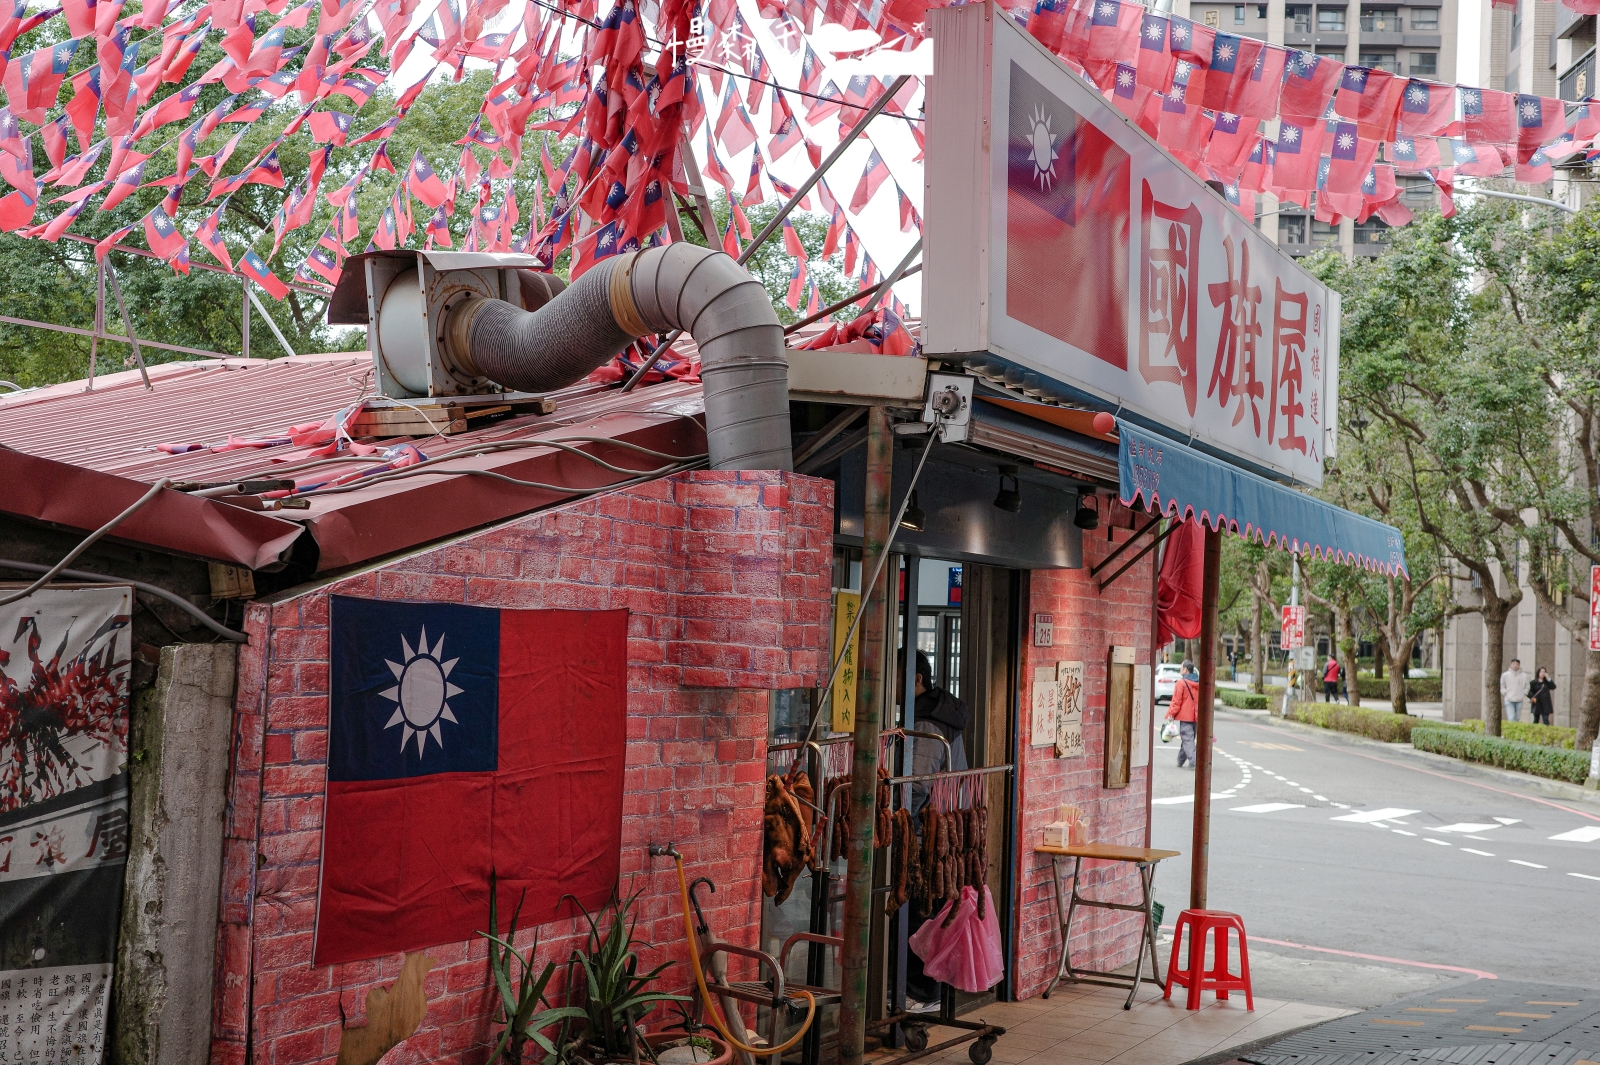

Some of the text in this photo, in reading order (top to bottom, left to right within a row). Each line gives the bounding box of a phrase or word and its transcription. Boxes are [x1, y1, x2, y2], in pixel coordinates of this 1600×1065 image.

[1138, 178, 1309, 456] 國旗屋
[1035, 692, 1045, 734] 公休
